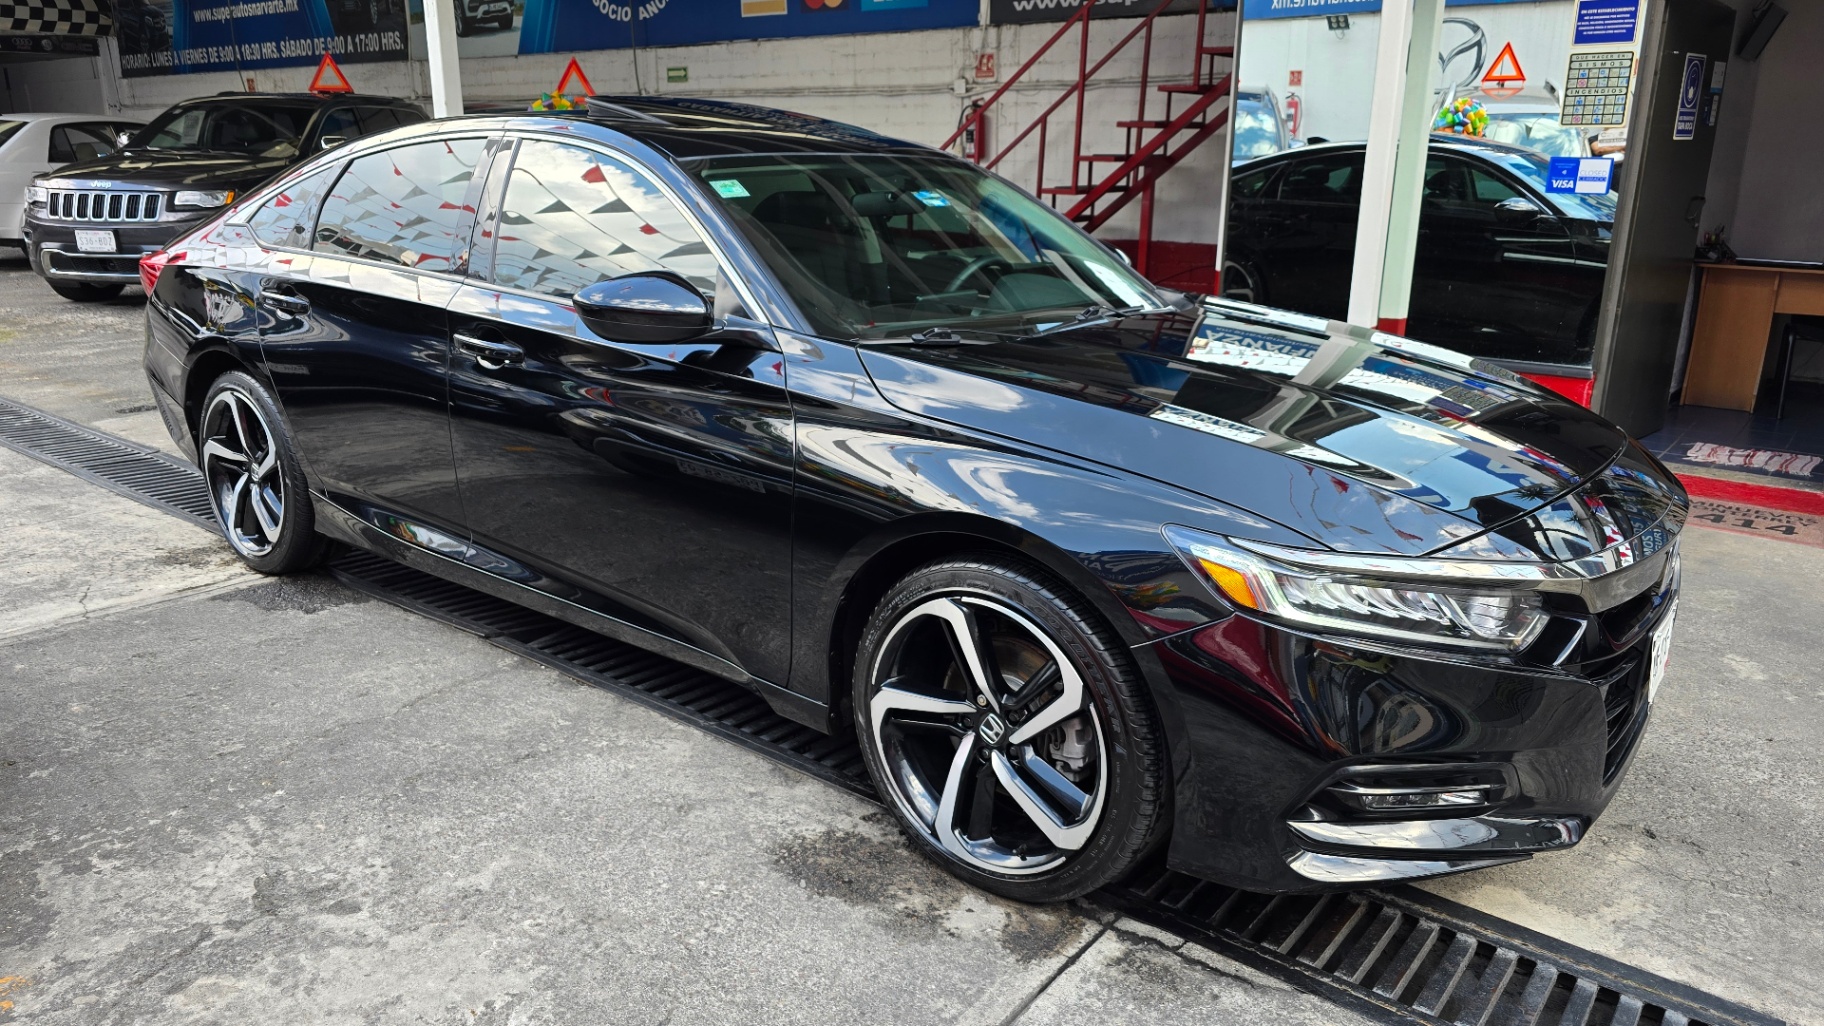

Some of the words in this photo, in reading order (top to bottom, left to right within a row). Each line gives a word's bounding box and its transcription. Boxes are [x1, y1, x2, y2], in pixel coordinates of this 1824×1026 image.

[1013, 0, 1138, 11] www.
[121, 52, 152, 70] HORARIO:
[151, 51, 173, 68] LUNES
[173, 49, 181, 66] A
[181, 47, 208, 65] VIERNES
[208, 46, 219, 63] DE
[219, 45, 235, 63] 9:00
[241, 43, 261, 61] 18:30
[261, 42, 280, 60] HRS.
[280, 36, 313, 59] SÁBADO
[314, 37, 326, 56] DE
[326, 35, 346, 55] 9:00
[347, 34, 355, 54] A
[355, 32, 380, 53] 17:00
[381, 30, 405, 51] HRS.
[1579, 169, 1608, 177] CLOSED
[90, 180, 112, 189] Jeep
[1551, 179, 1575, 189] VISA
[1692, 513, 1799, 536] 414
